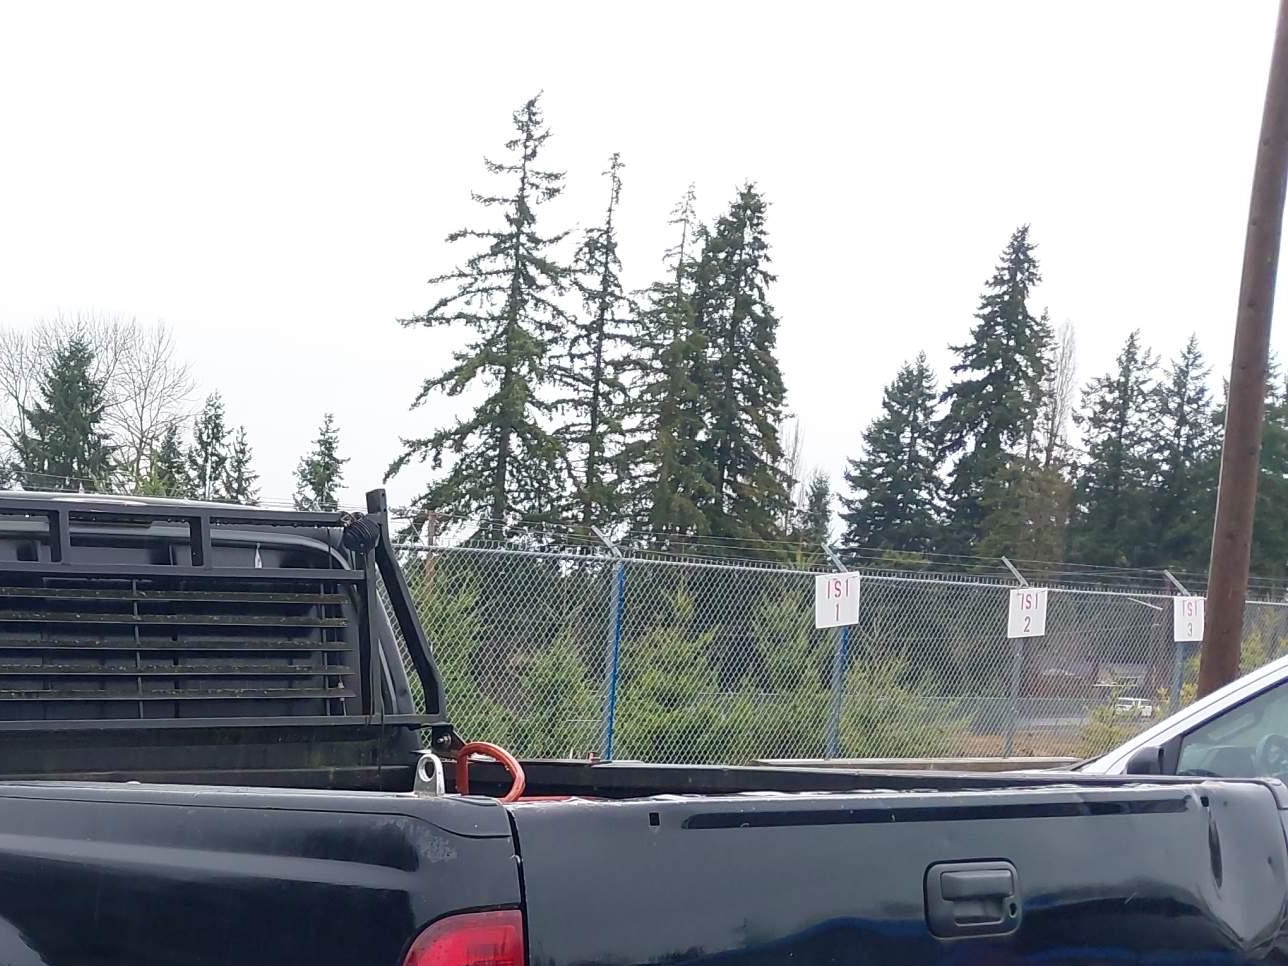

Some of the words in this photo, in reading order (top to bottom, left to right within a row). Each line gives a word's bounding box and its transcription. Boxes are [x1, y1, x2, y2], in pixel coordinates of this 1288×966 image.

[835, 604, 840, 622] 1
[1023, 616, 1031, 633] 2
[1187, 622, 1193, 637] 3
